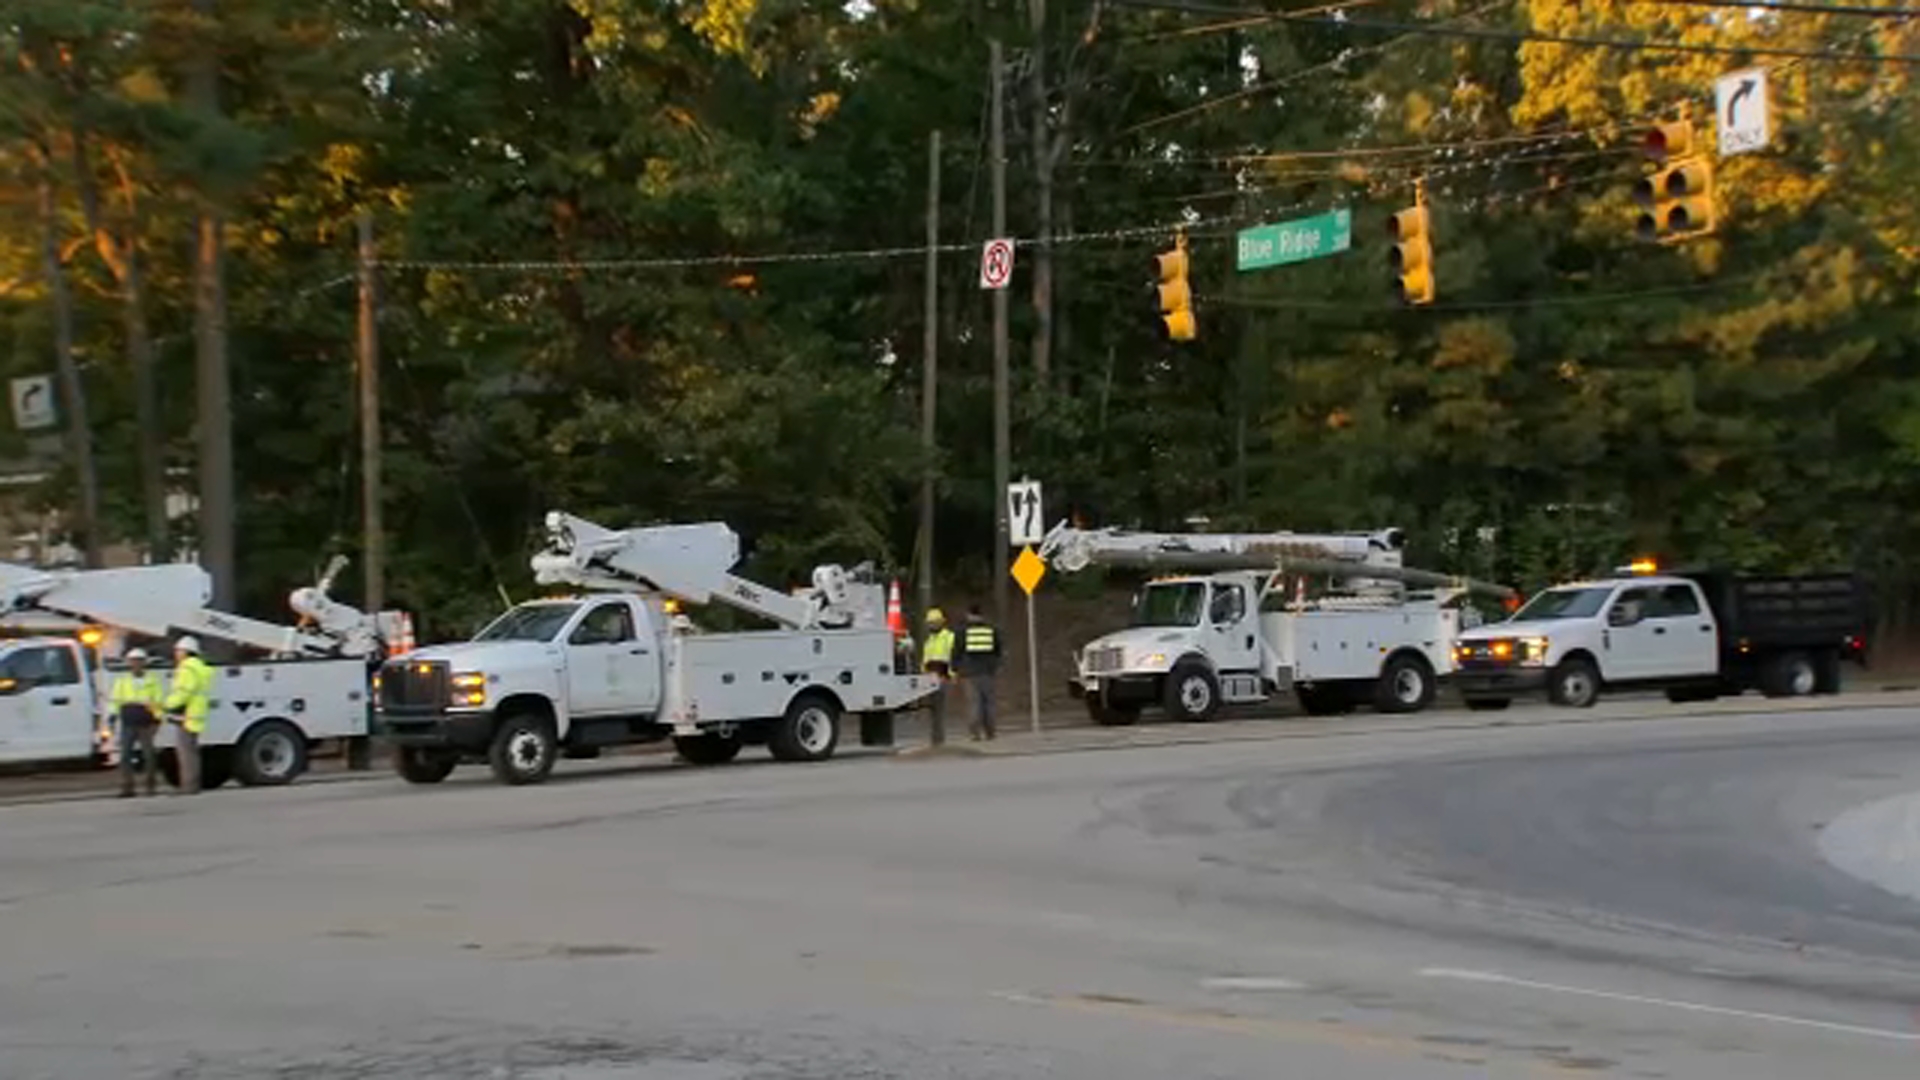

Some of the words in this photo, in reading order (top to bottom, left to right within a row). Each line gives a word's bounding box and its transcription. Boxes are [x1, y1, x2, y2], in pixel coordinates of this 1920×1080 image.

[1724, 127, 1763, 150] ONLY
[1239, 237, 1272, 260] Blue
[1279, 228, 1321, 258] Ridge
